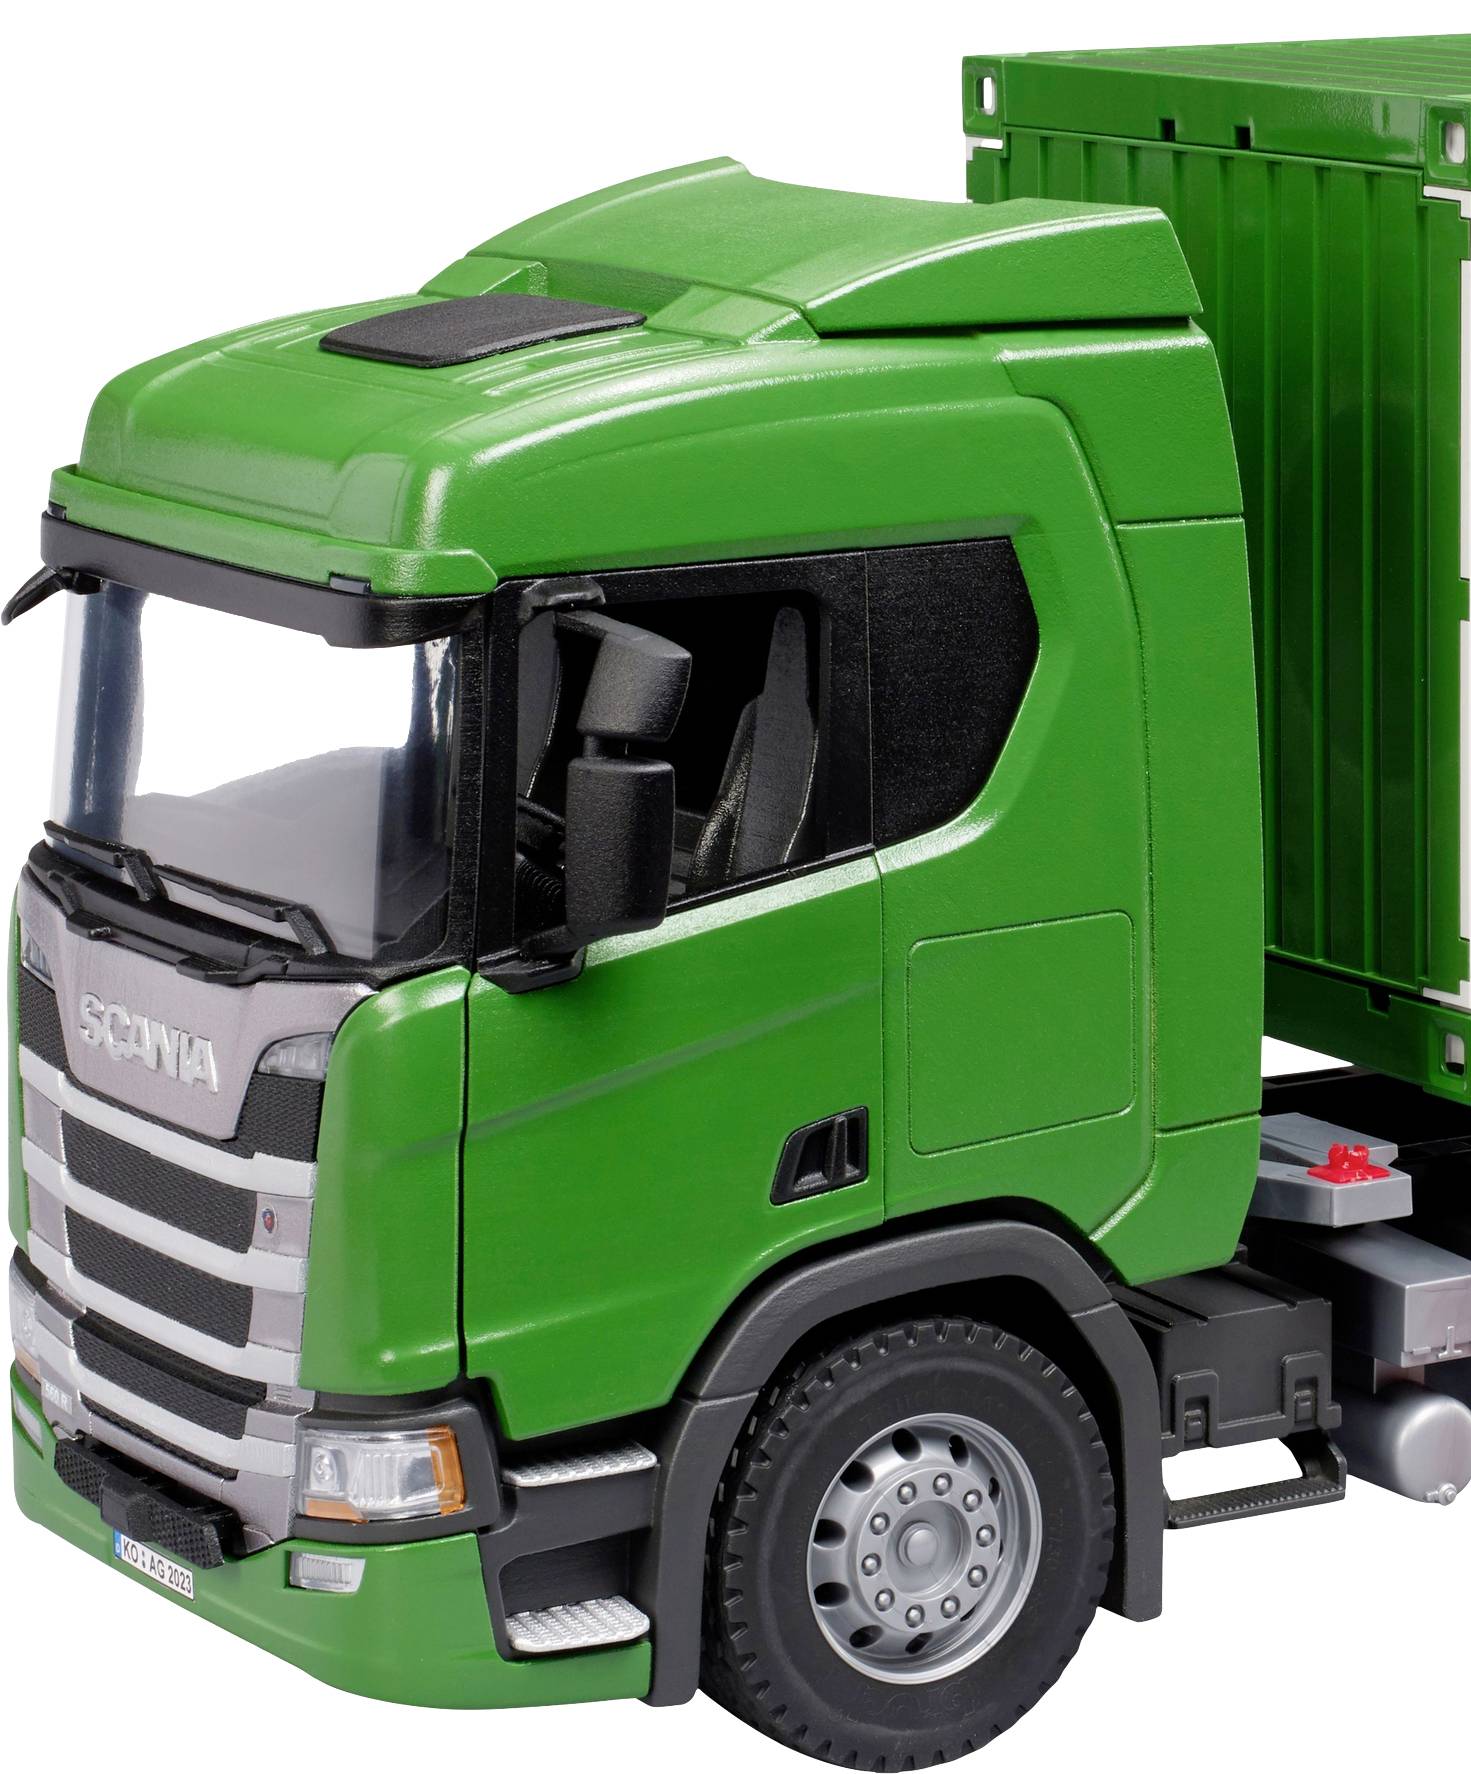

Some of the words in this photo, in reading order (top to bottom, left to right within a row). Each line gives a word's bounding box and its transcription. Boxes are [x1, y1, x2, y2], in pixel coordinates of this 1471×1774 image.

[79, 992, 218, 1094] SCANIA
[123, 1539, 138, 1563] KO
[149, 1554, 165, 1580] AG
[167, 1565, 192, 1594] 2023
